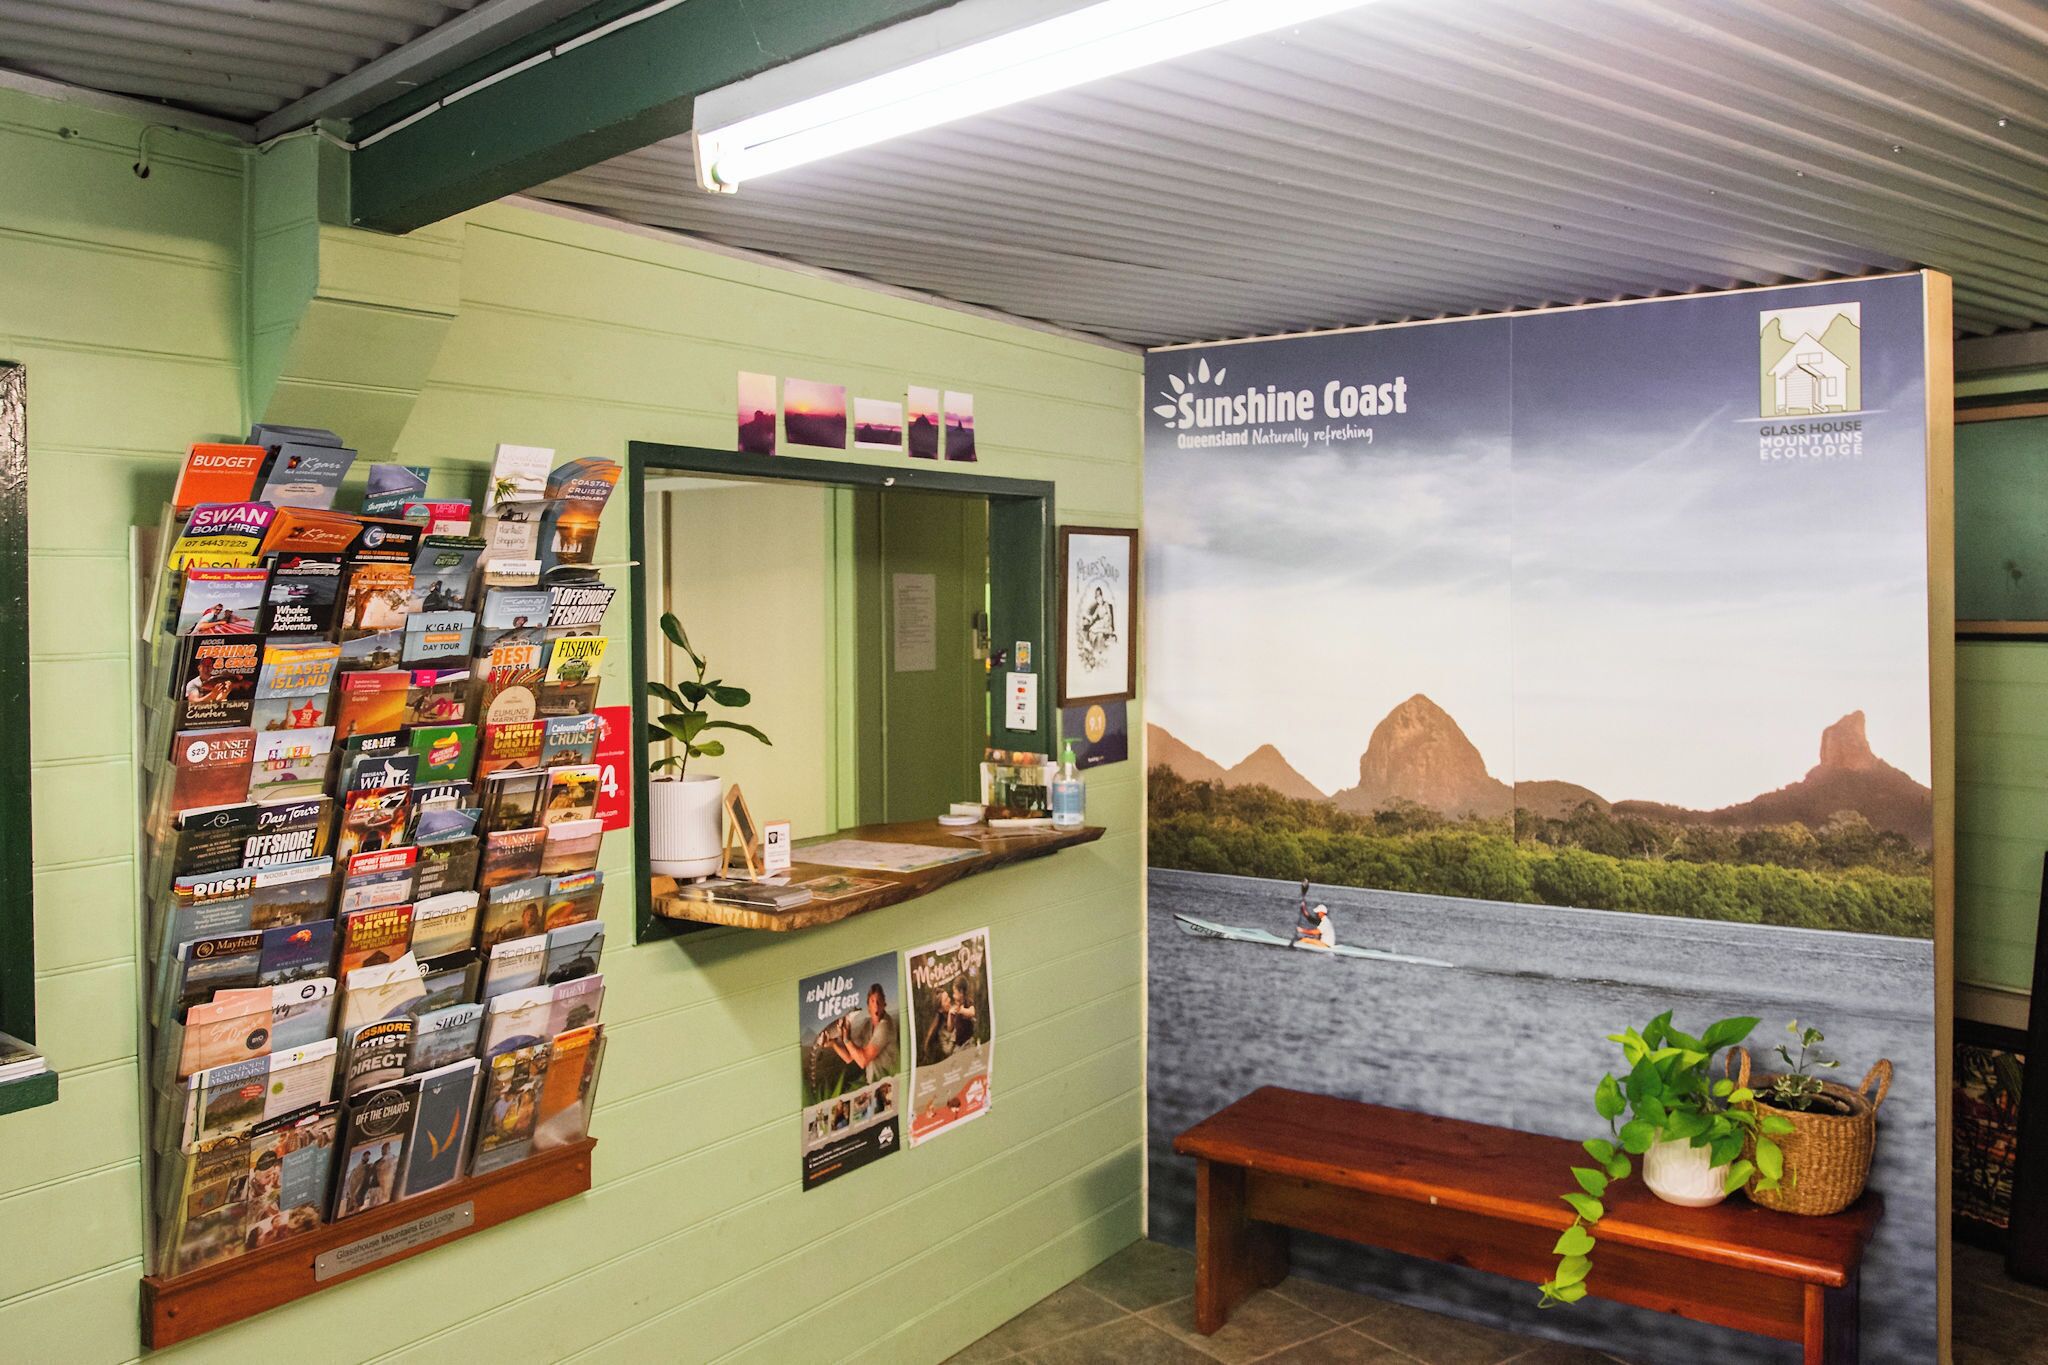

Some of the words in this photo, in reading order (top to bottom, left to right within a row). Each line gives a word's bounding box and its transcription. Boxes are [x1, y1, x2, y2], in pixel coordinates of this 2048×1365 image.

[1178, 384, 1314, 430] Sunshine
[1323, 376, 1407, 419] Coast
[1760, 424, 1806, 437] GLASS
[1810, 421, 1862, 433] HOUSE
[1177, 429, 1248, 450] Queensland
[1252, 425, 1309, 448] Naturally
[1314, 424, 1373, 445] refreshing
[1760, 431, 1863, 448] MOUNTAINS
[1760, 443, 1863, 460] ECOLODGE
[193, 455, 256, 468] BUDGET
[571, 478, 611, 488] COASTAL
[567, 486, 608, 496] CRUISES
[367, 499, 400, 512] Shopping
[195, 507, 268, 525] SWAN
[191, 524, 226, 534] BOAT
[227, 522, 260, 534] HIRE
[277, 606, 309, 615] Whales
[551, 604, 605, 626] FISHING
[273, 615, 312, 623] Dolphins
[271, 622, 318, 632] Adventure
[425, 622, 463, 632] K'GARI
[194, 644, 257, 660] FISHING
[422, 644, 438, 652] DAY
[558, 641, 605, 658] FISHING
[213, 658, 224, 669] &
[492, 646, 534, 667] BEST
[274, 663, 332, 676] FRASER
[270, 674, 329, 689] ISLAND
[221, 701, 249, 711] Fishing
[186, 709, 228, 719] Charters
[301, 711, 312, 720] 30
[551, 724, 586, 733] Caloundra
[1089, 716, 1103, 731] 9.1
[209, 739, 251, 751] SUNSET
[549, 733, 595, 747] CRUISE
[191, 747, 206, 757] $25
[208, 749, 248, 761] CRUISE
[601, 764, 619, 798] 4
[260, 811, 287, 827] Day
[286, 804, 320, 821] Tours
[244, 828, 316, 857] OFFSHORE
[353, 857, 379, 867] AIRPORT
[379, 853, 408, 863] SHUTTLES
[264, 870, 288, 880] NOOSA
[291, 865, 320, 876] CRUISER
[193, 876, 251, 899] RUSH
[444, 914, 467, 924] VIEW
[216, 935, 259, 952] Mayfield
[959, 944, 984, 972] Day
[806, 987, 816, 1003] AS
[815, 974, 844, 1002] WILD
[844, 977, 854, 991] AS
[817, 995, 842, 1021] LIFE
[841, 992, 860, 1010] GETS
[435, 1012, 473, 1030] SHOP
[351, 1053, 407, 1079] DIRECT
[356, 1112, 370, 1126] OFF
[370, 1108, 383, 1122] THE
[383, 1101, 411, 1119] CHARTS
[336, 1238, 380, 1260] Glasshouse
[381, 1223, 418, 1243] Mountains
[419, 1220, 433, 1230] Eco
[434, 1211, 456, 1226] Lodge
